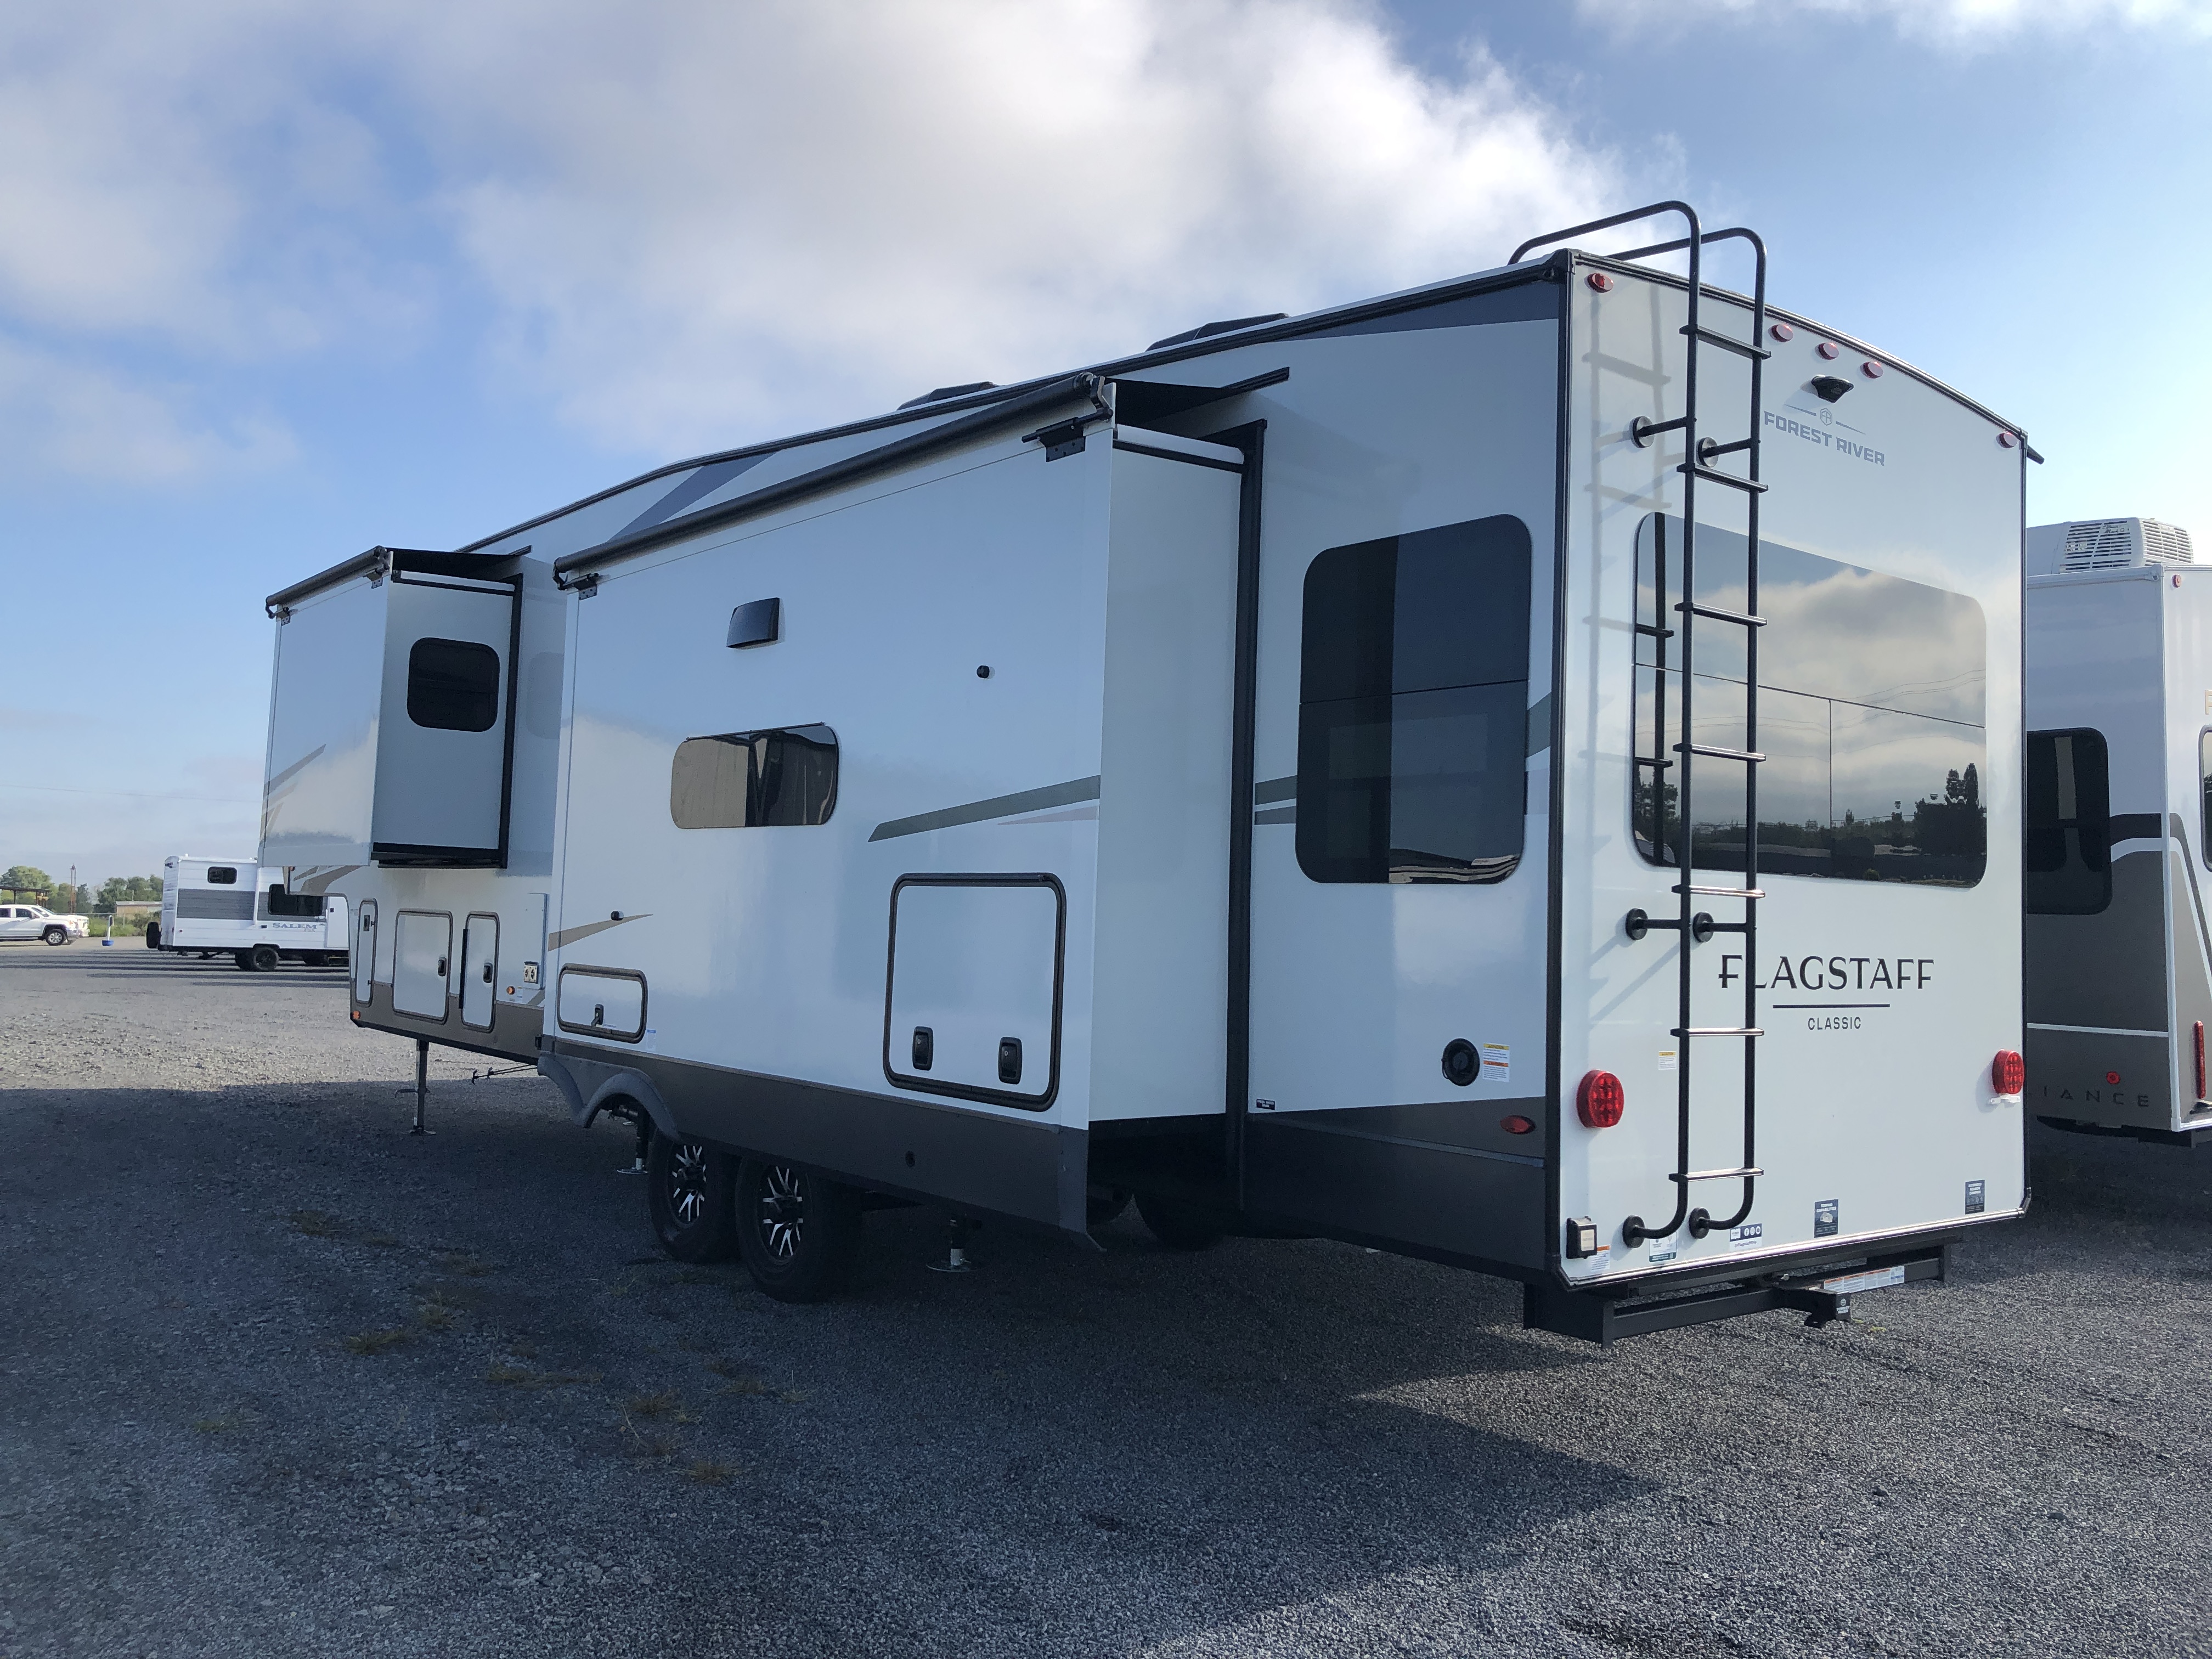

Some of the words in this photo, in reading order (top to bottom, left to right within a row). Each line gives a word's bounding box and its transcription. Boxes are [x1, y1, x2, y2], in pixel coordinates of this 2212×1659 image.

[1763, 410, 1832, 447] FOREST
[1836, 437, 1885, 467] RIVER
[1808, 1016, 1861, 1031] CLASSIC
